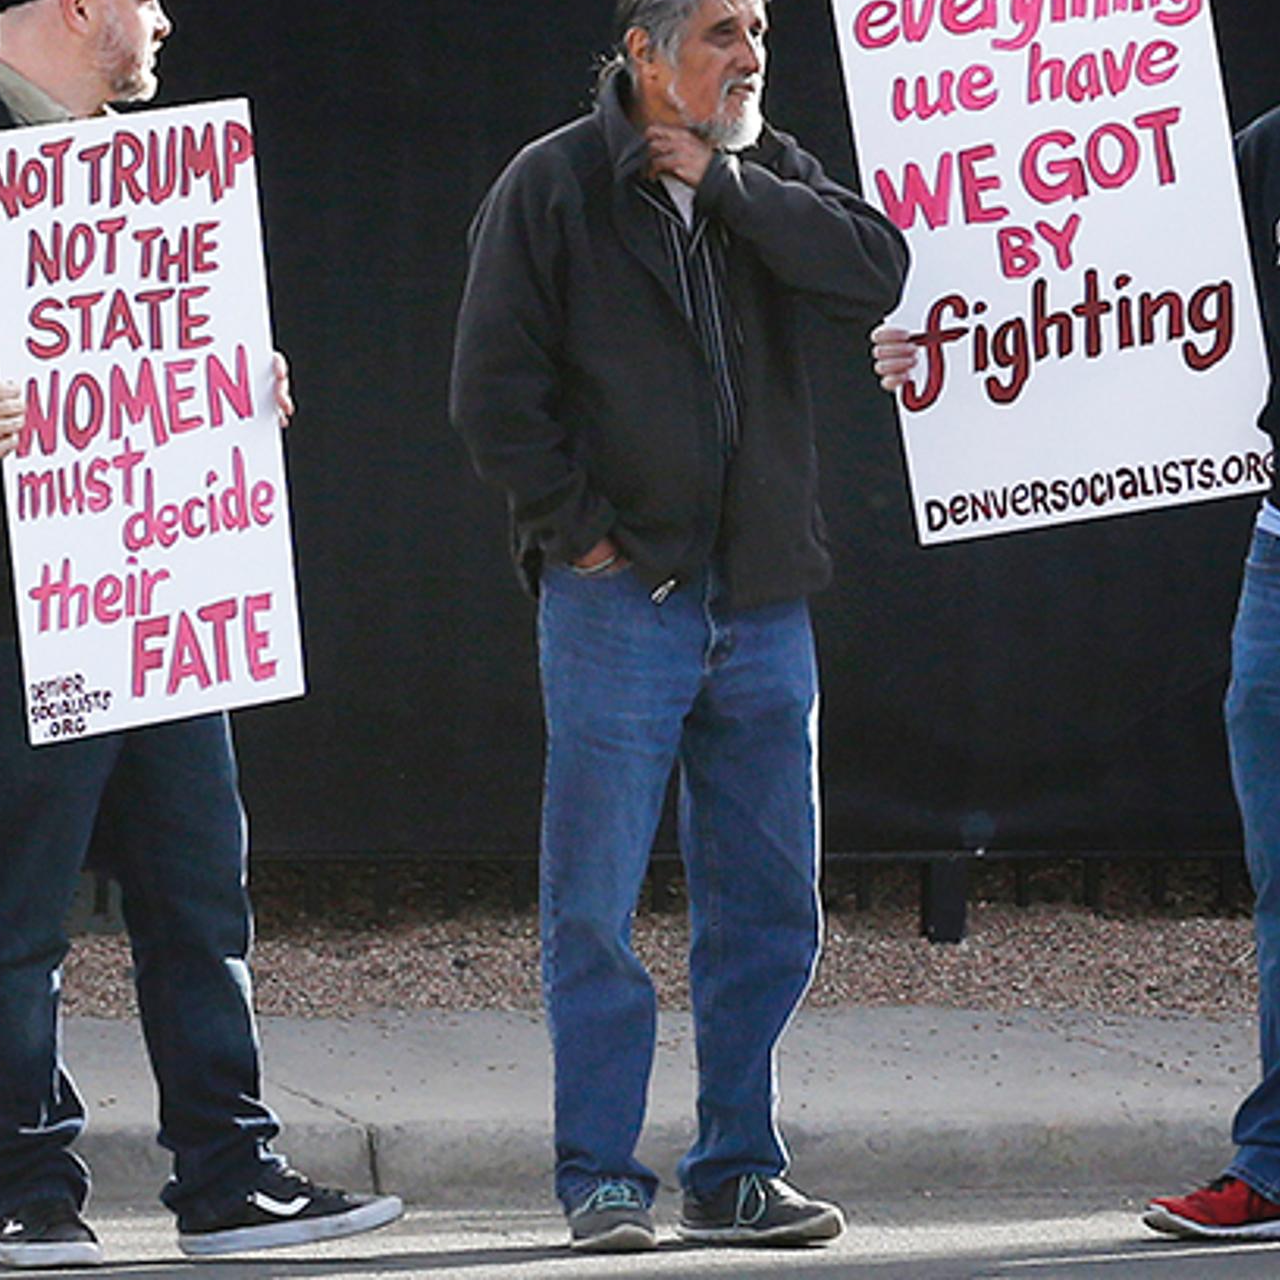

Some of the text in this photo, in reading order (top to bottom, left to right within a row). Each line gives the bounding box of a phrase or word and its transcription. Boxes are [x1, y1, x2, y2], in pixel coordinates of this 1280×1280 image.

[892, 39, 1180, 122] we have
[78, 120, 255, 208] TRUMP
[874, 107, 1181, 230] WE GOT
[25, 216, 220, 288] NOT THE
[997, 214, 1081, 279] BY
[25, 286, 214, 361] STATE
[902, 268, 1234, 412] fighting
[16, 344, 254, 459] WOMEN
[17, 436, 145, 521] must
[122, 445, 276, 552] decide
[28, 555, 171, 634] their
[131, 593, 278, 698] FATE
